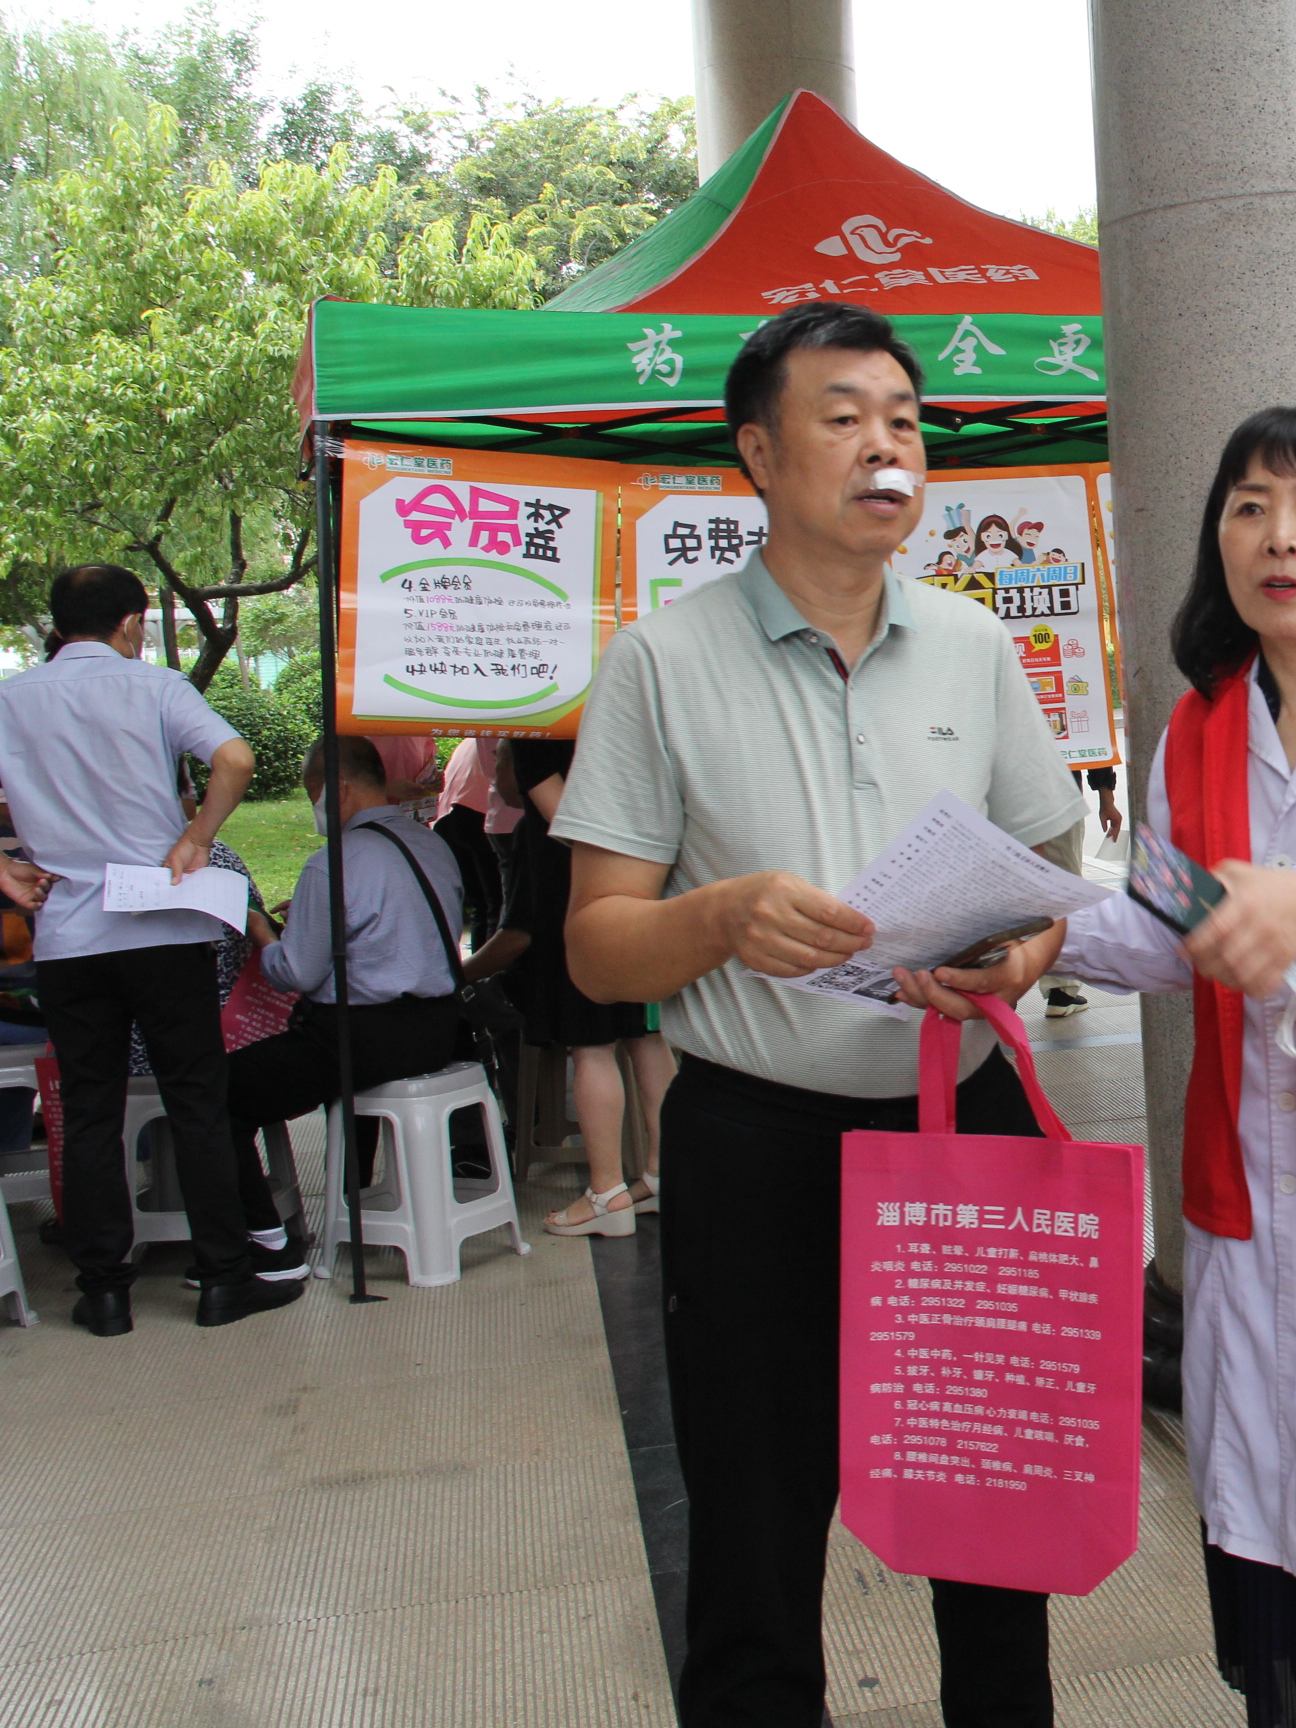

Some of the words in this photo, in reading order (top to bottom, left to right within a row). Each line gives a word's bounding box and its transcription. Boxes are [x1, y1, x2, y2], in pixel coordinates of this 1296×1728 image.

[760, 264, 1040, 305] 宏仁堂医药
[659, 474, 722, 486] 宏仁堂医药
[395, 484, 522, 556] 会员
[998, 564, 1080, 586] 每周六周日
[876, 1201, 1100, 1239] 淄博市第三人民医院
[998, 1266, 1040, 1279] 2951185
[976, 1299, 1018, 1312] 2951035
[869, 1331, 916, 1342] 2951579
[956, 1439, 999, 1453] 2157622
